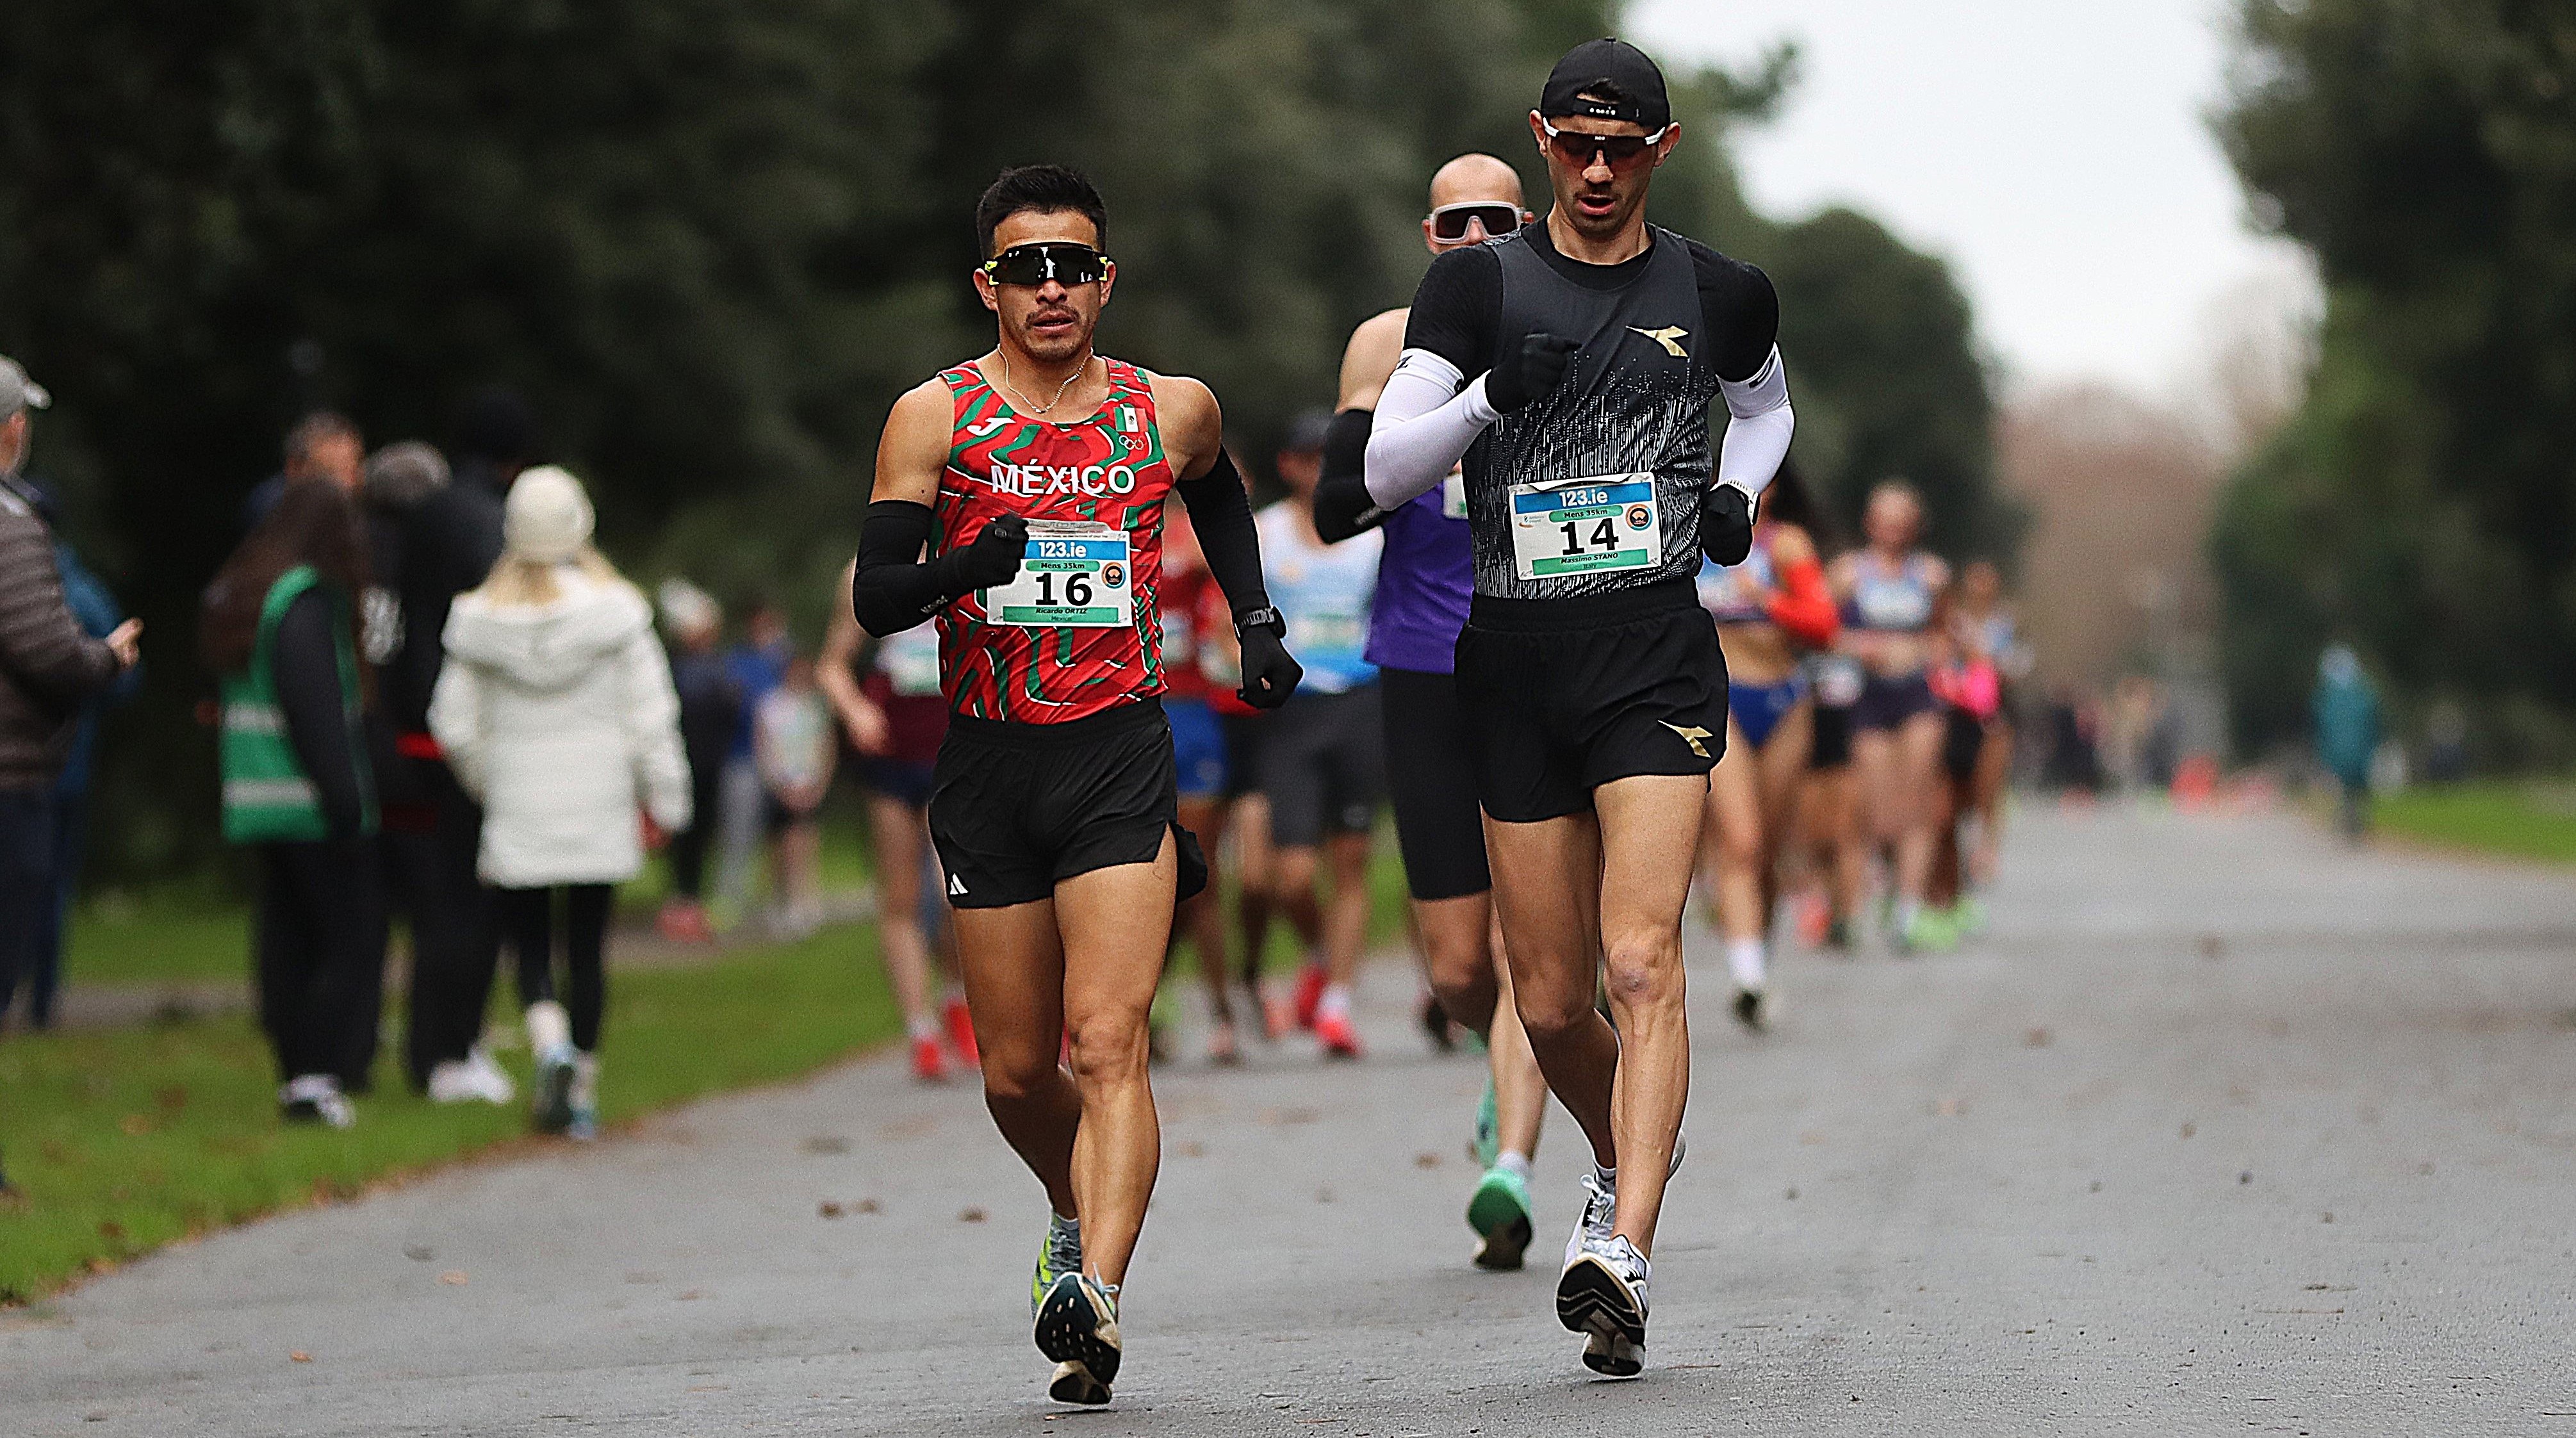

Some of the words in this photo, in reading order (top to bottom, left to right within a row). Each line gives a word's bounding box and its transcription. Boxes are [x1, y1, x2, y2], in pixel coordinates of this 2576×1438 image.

[991, 459, 1135, 494] MÉXICO
[1559, 489, 1608, 507] 123.ie
[1038, 541, 1087, 558] 123.ie
[1560, 518, 1619, 555] 14
[1035, 572, 1092, 607] 16
